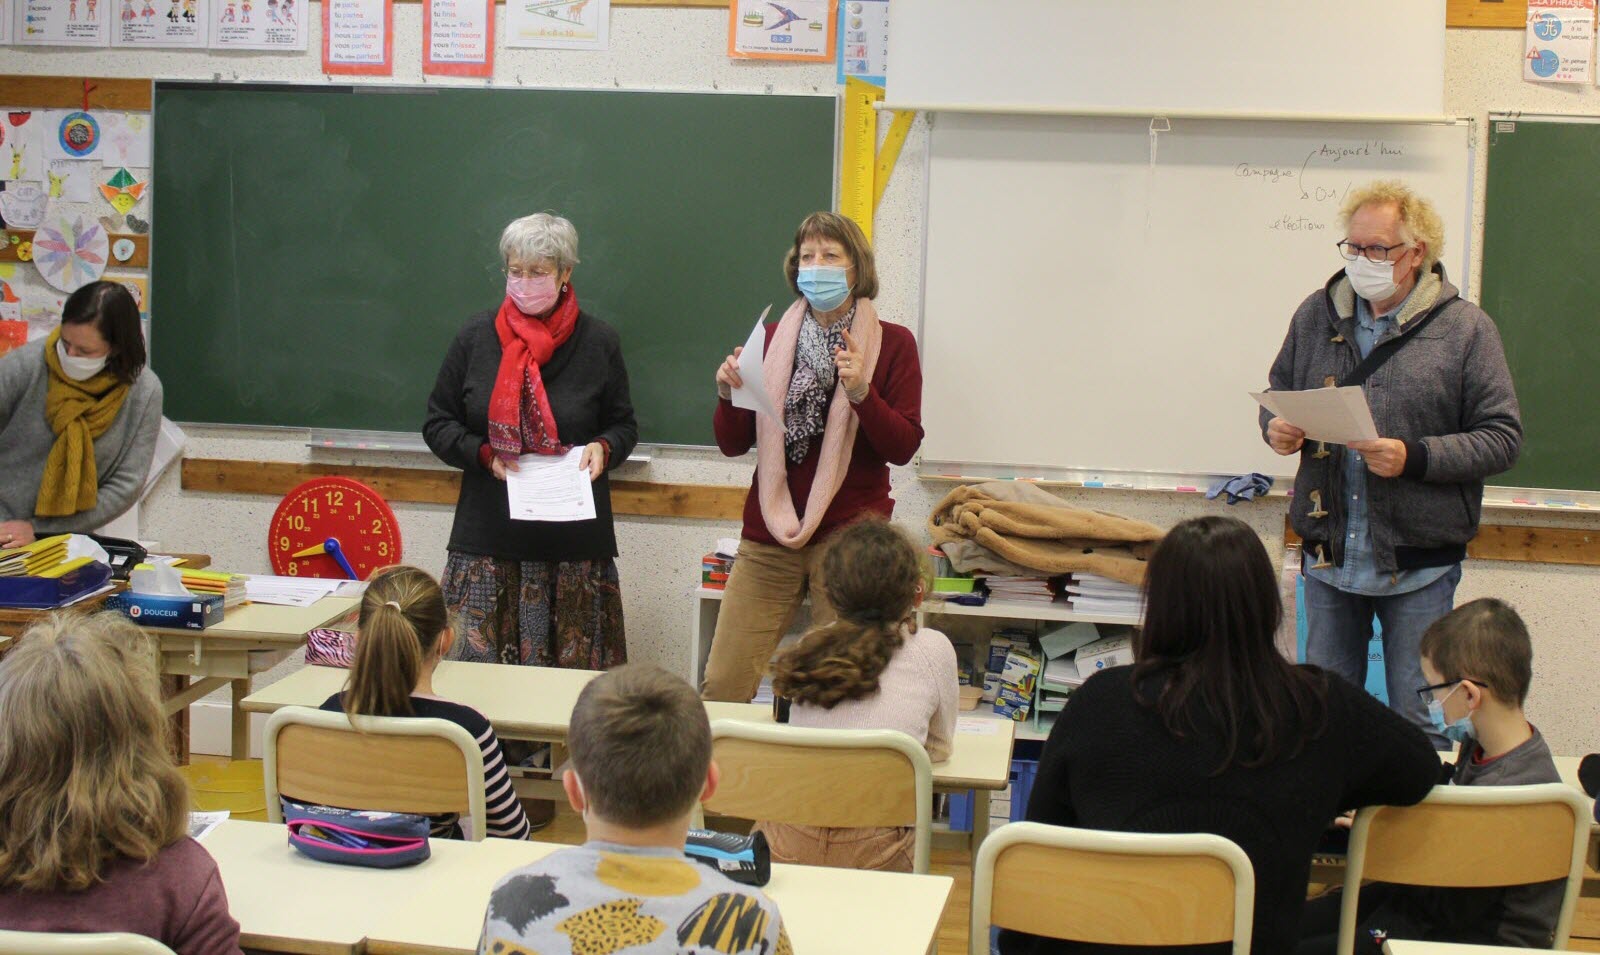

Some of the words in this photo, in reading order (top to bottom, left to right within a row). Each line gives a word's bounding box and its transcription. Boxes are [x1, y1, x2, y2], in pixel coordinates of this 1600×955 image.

[1235, 162, 1294, 183] Campagne
[301, 498, 318, 513] 11
[325, 491, 344, 507] 12
[354, 500, 362, 515] 1
[286, 515, 305, 531] 10
[372, 519, 383, 534] 2
[280, 536, 290, 552] 9
[378, 541, 388, 557] 3
[288, 561, 298, 576] 8
[144, 609, 178, 617] DOUCEUR
